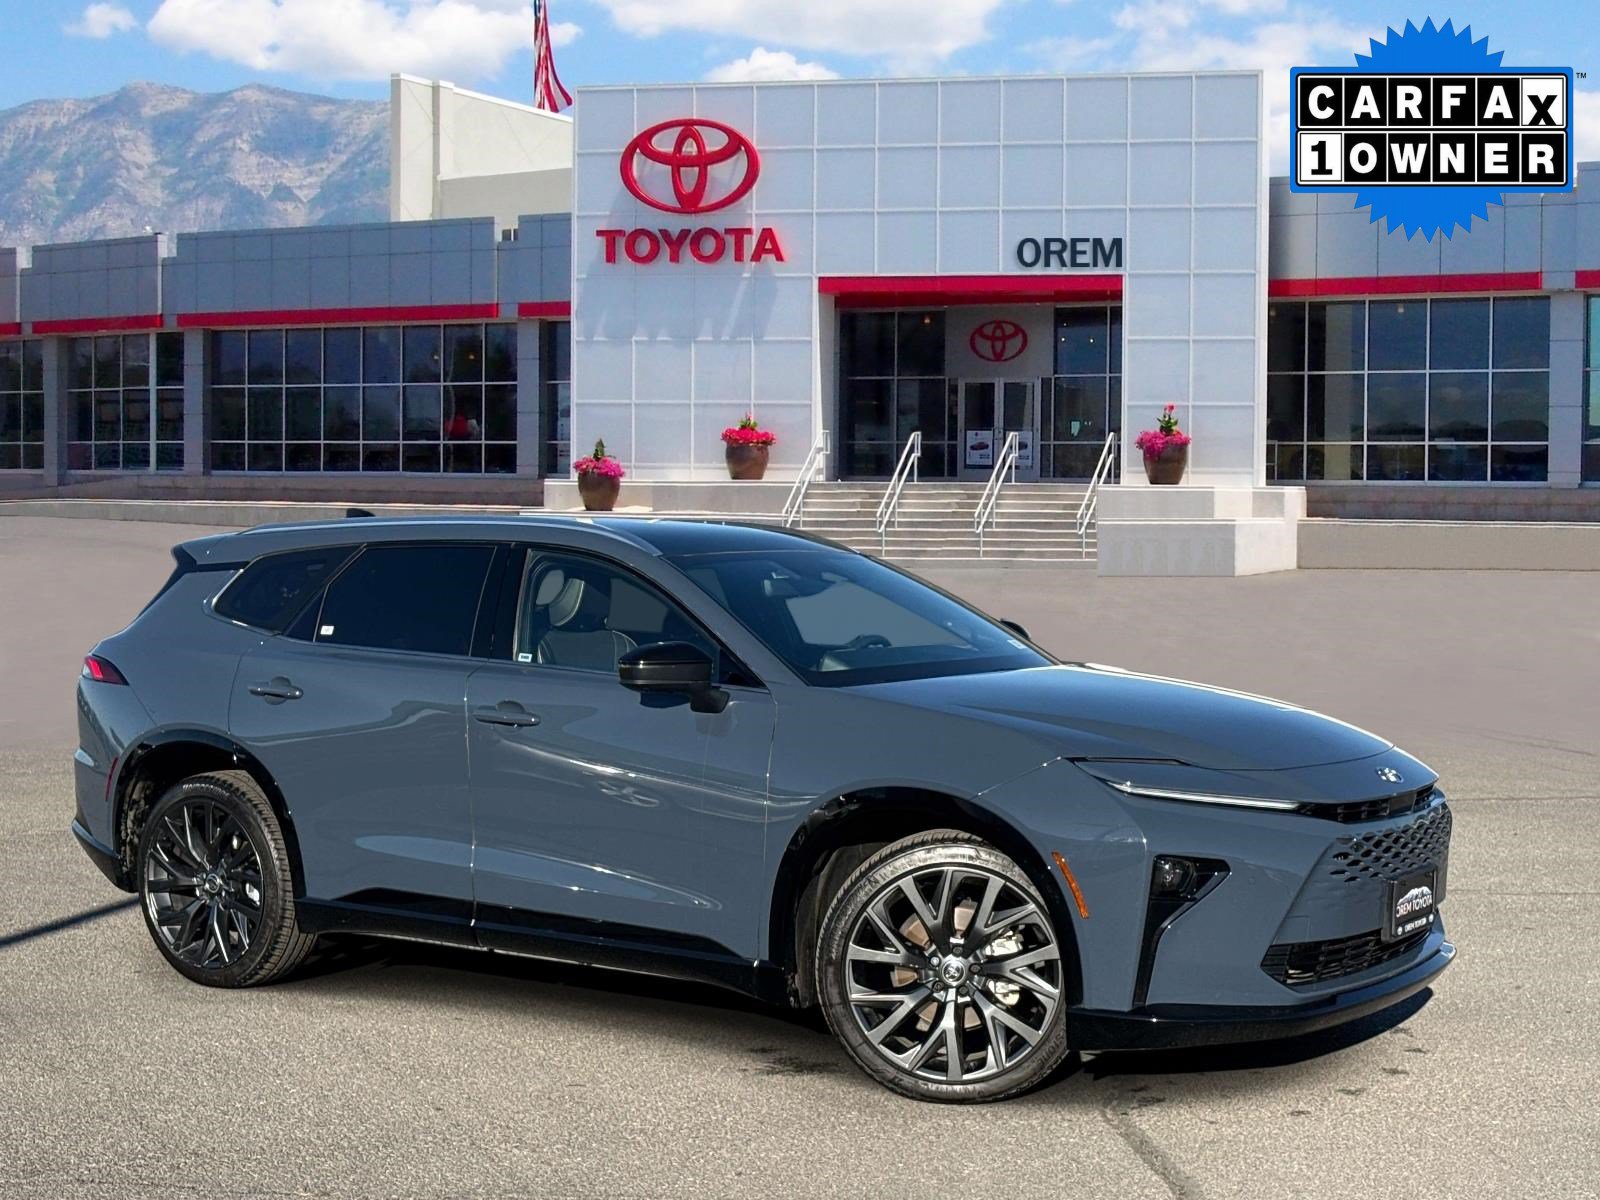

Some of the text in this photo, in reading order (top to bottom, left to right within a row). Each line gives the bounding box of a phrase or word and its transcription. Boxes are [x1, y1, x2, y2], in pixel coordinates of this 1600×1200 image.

[595, 227, 785, 265] TOYOTA
[1016, 237, 1123, 268] OREM
[1396, 894, 1433, 918] OREM TOYOTA
